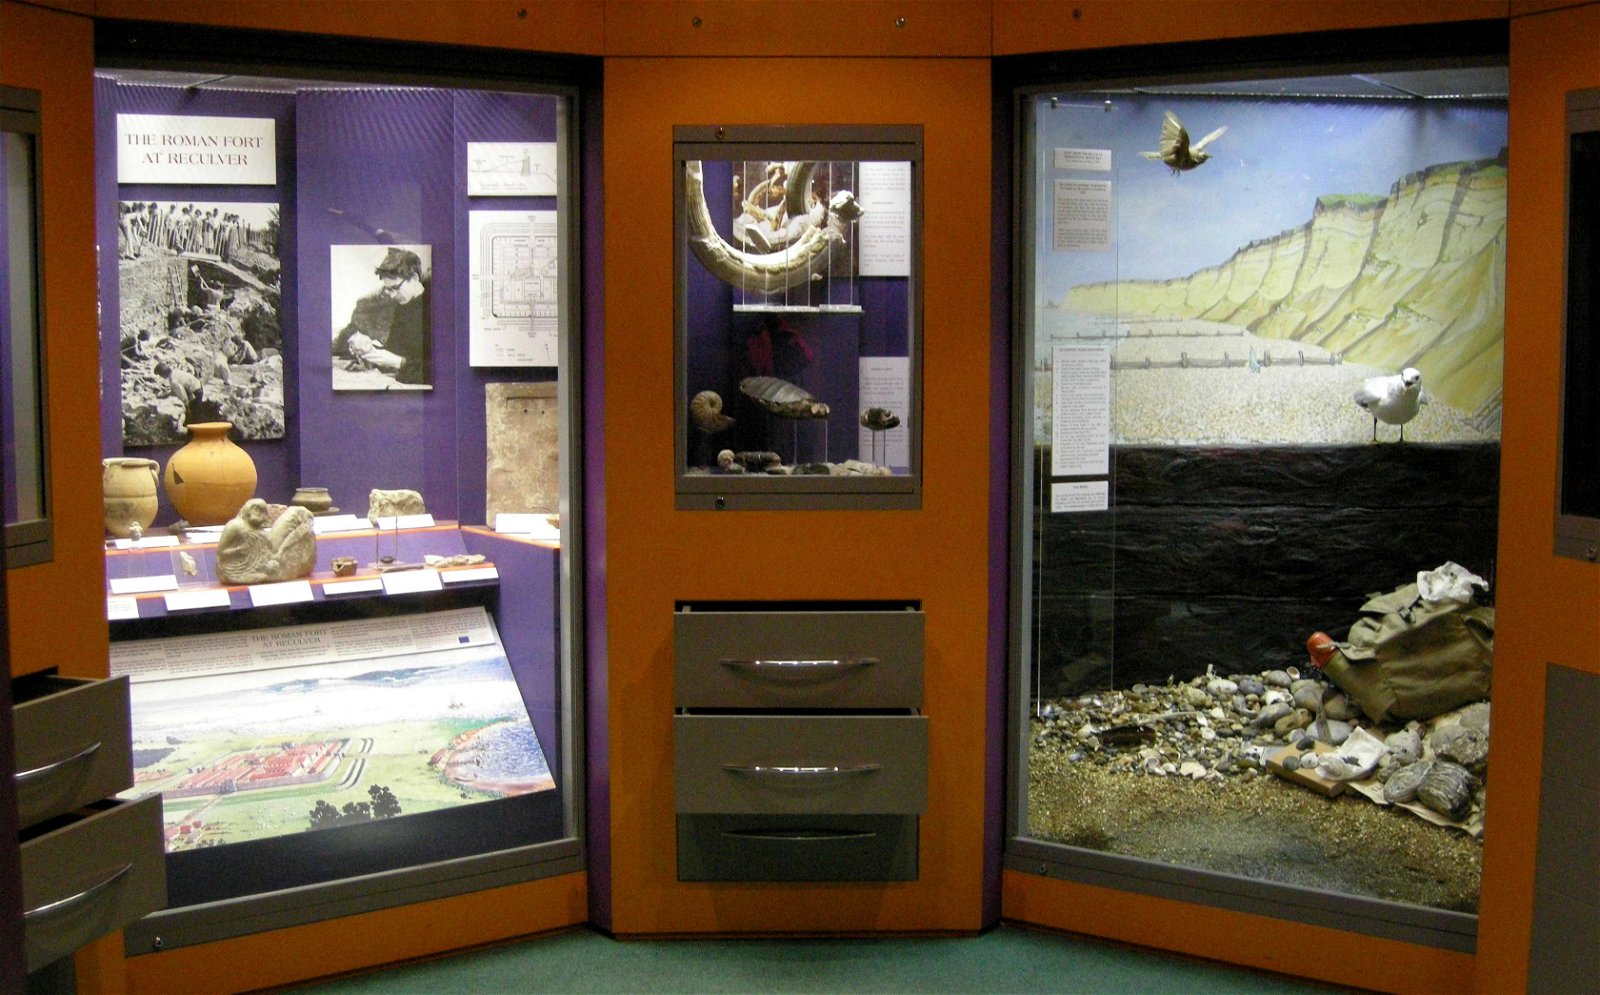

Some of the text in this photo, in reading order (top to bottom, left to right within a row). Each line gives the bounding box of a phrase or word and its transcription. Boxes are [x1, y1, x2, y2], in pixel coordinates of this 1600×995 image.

[125, 133, 264, 148] THE ROMAN FORT
[142, 153, 248, 166] AT RECULVER
[305, 629, 327, 637] FORT
[276, 638, 321, 647] RECULVER
